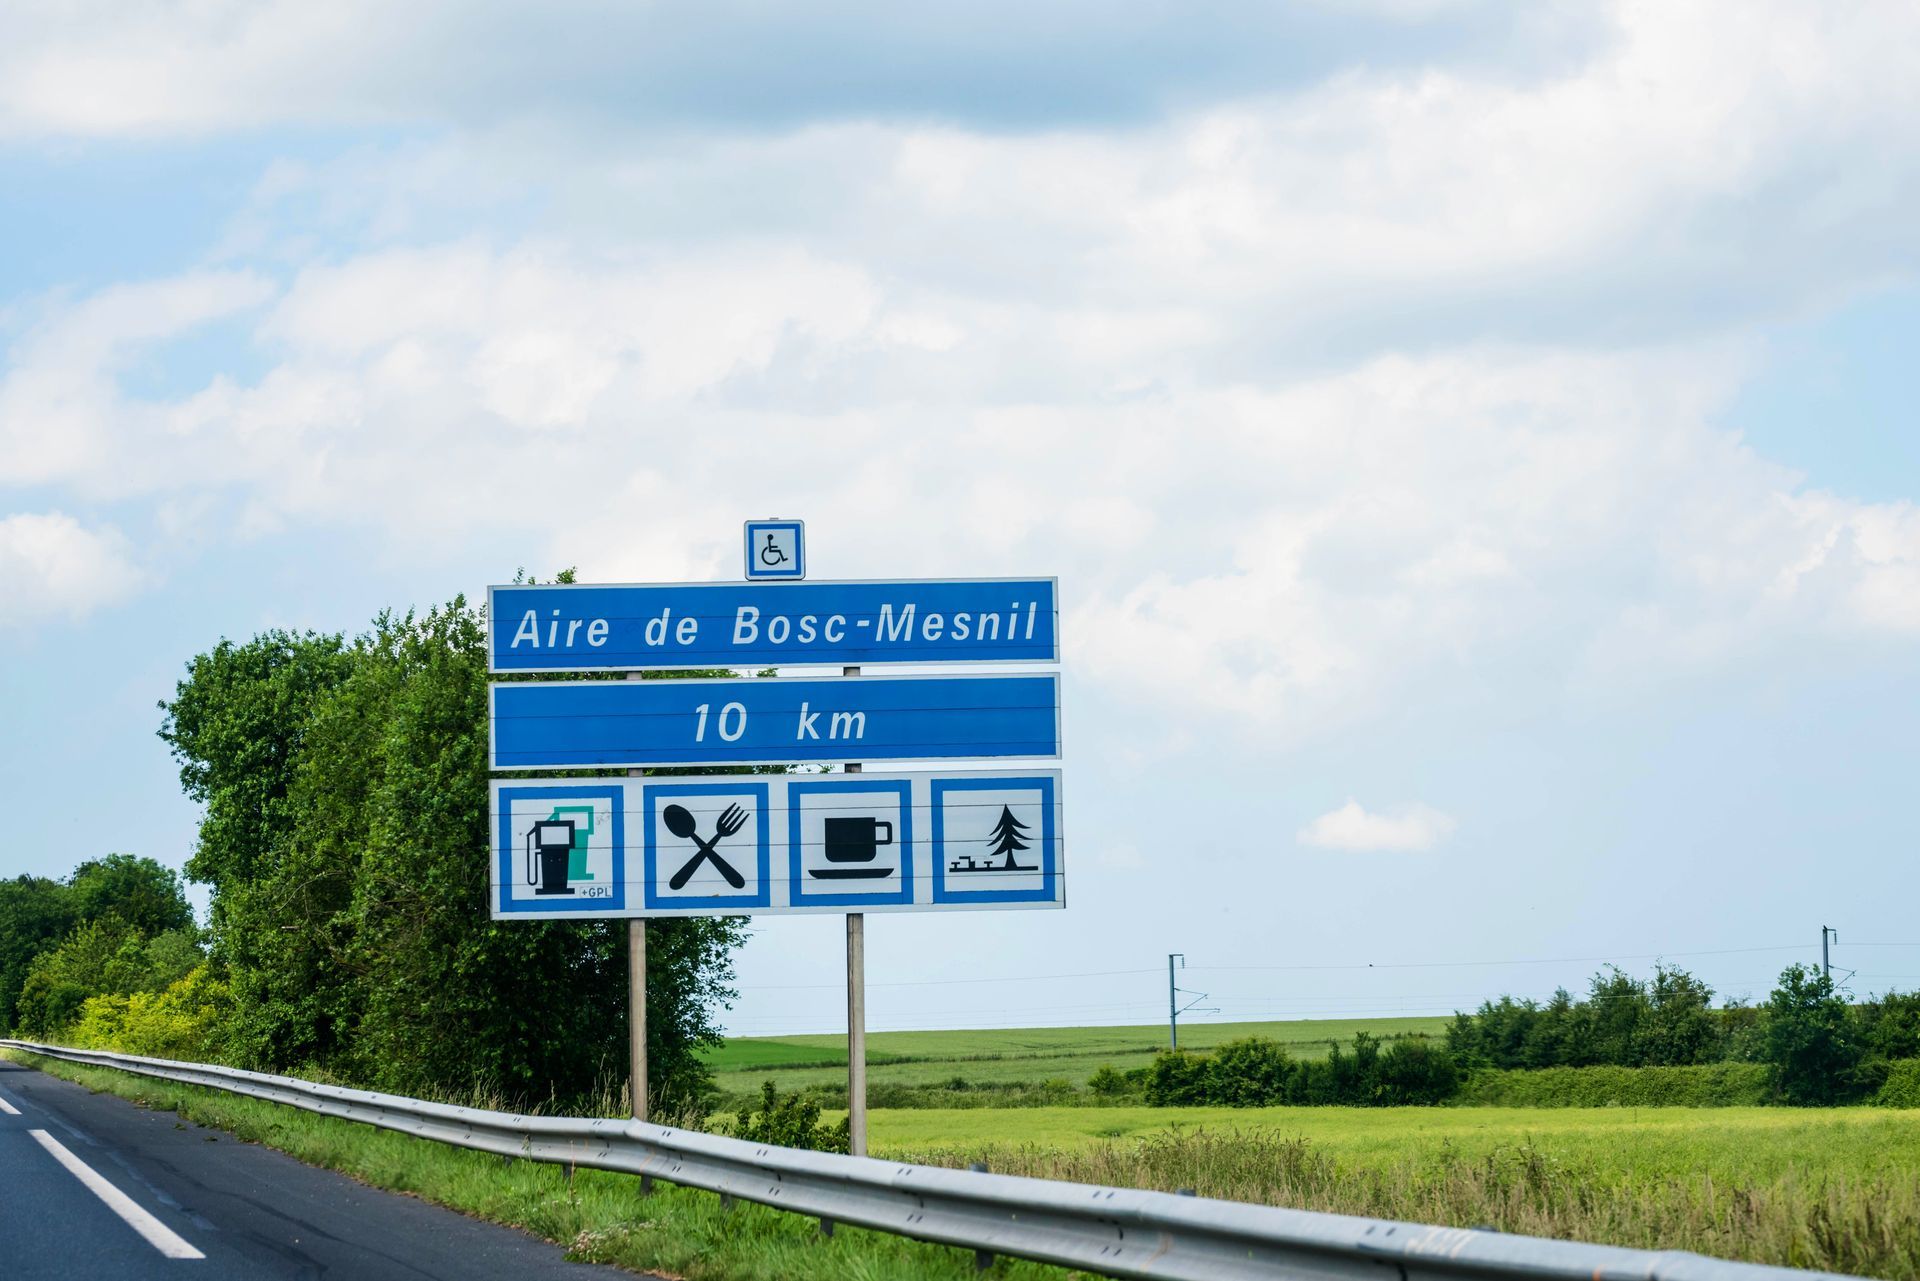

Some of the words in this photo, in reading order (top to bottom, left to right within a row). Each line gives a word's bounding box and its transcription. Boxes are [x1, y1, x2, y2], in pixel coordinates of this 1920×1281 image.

[510, 609, 610, 648] Aire
[645, 607, 699, 646] de
[732, 602, 1038, 644] Bosc-Mesnil
[694, 702, 748, 742] 10
[796, 702, 867, 740] km
